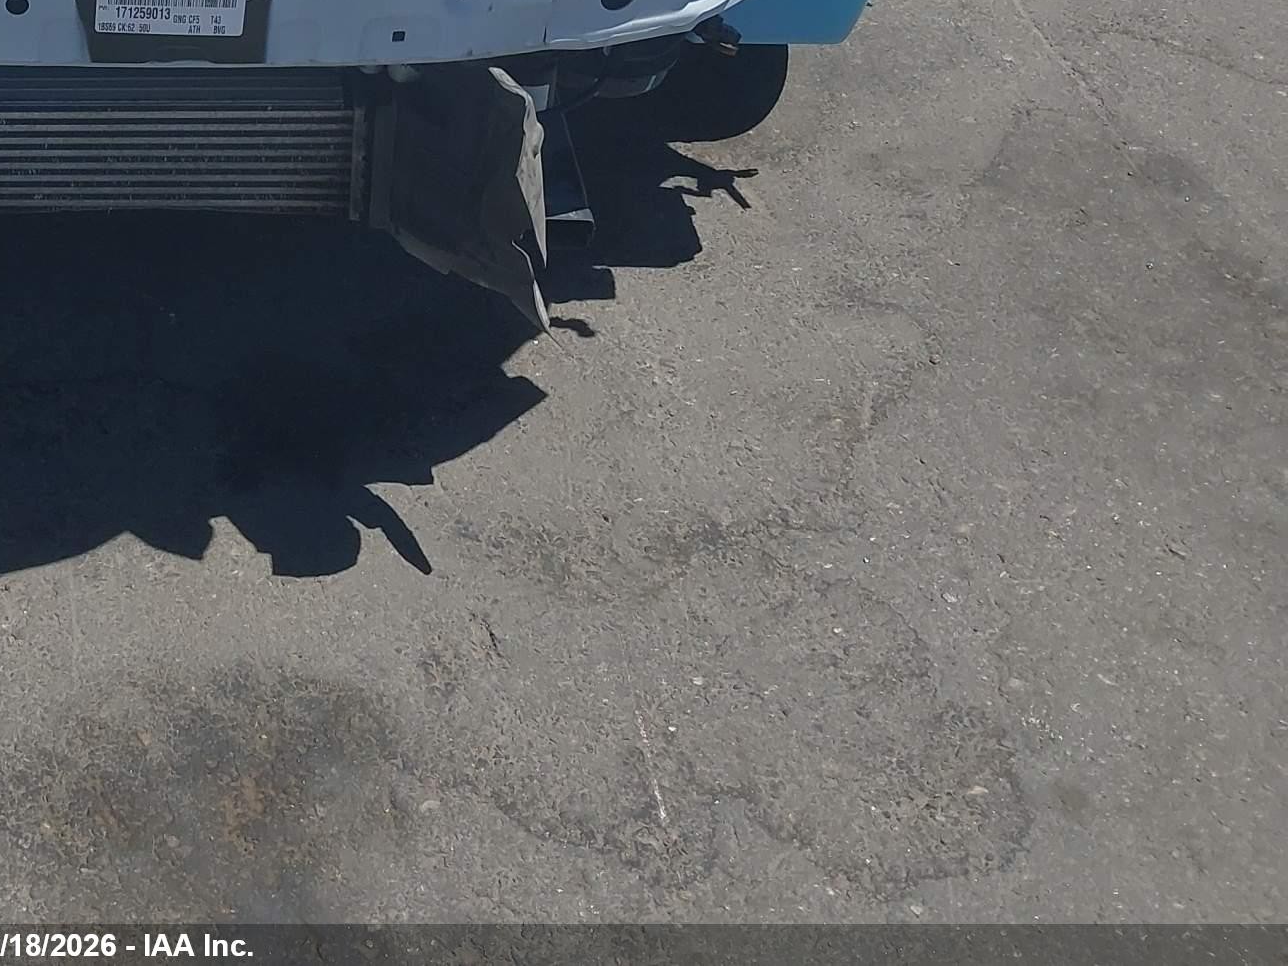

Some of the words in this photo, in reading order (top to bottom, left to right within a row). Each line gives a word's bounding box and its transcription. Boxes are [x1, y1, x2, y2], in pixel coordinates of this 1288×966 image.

[116, 7, 170, 19] 171259013
[189, 15, 200, 24] CF5
[188, 25, 200, 34] ATH
